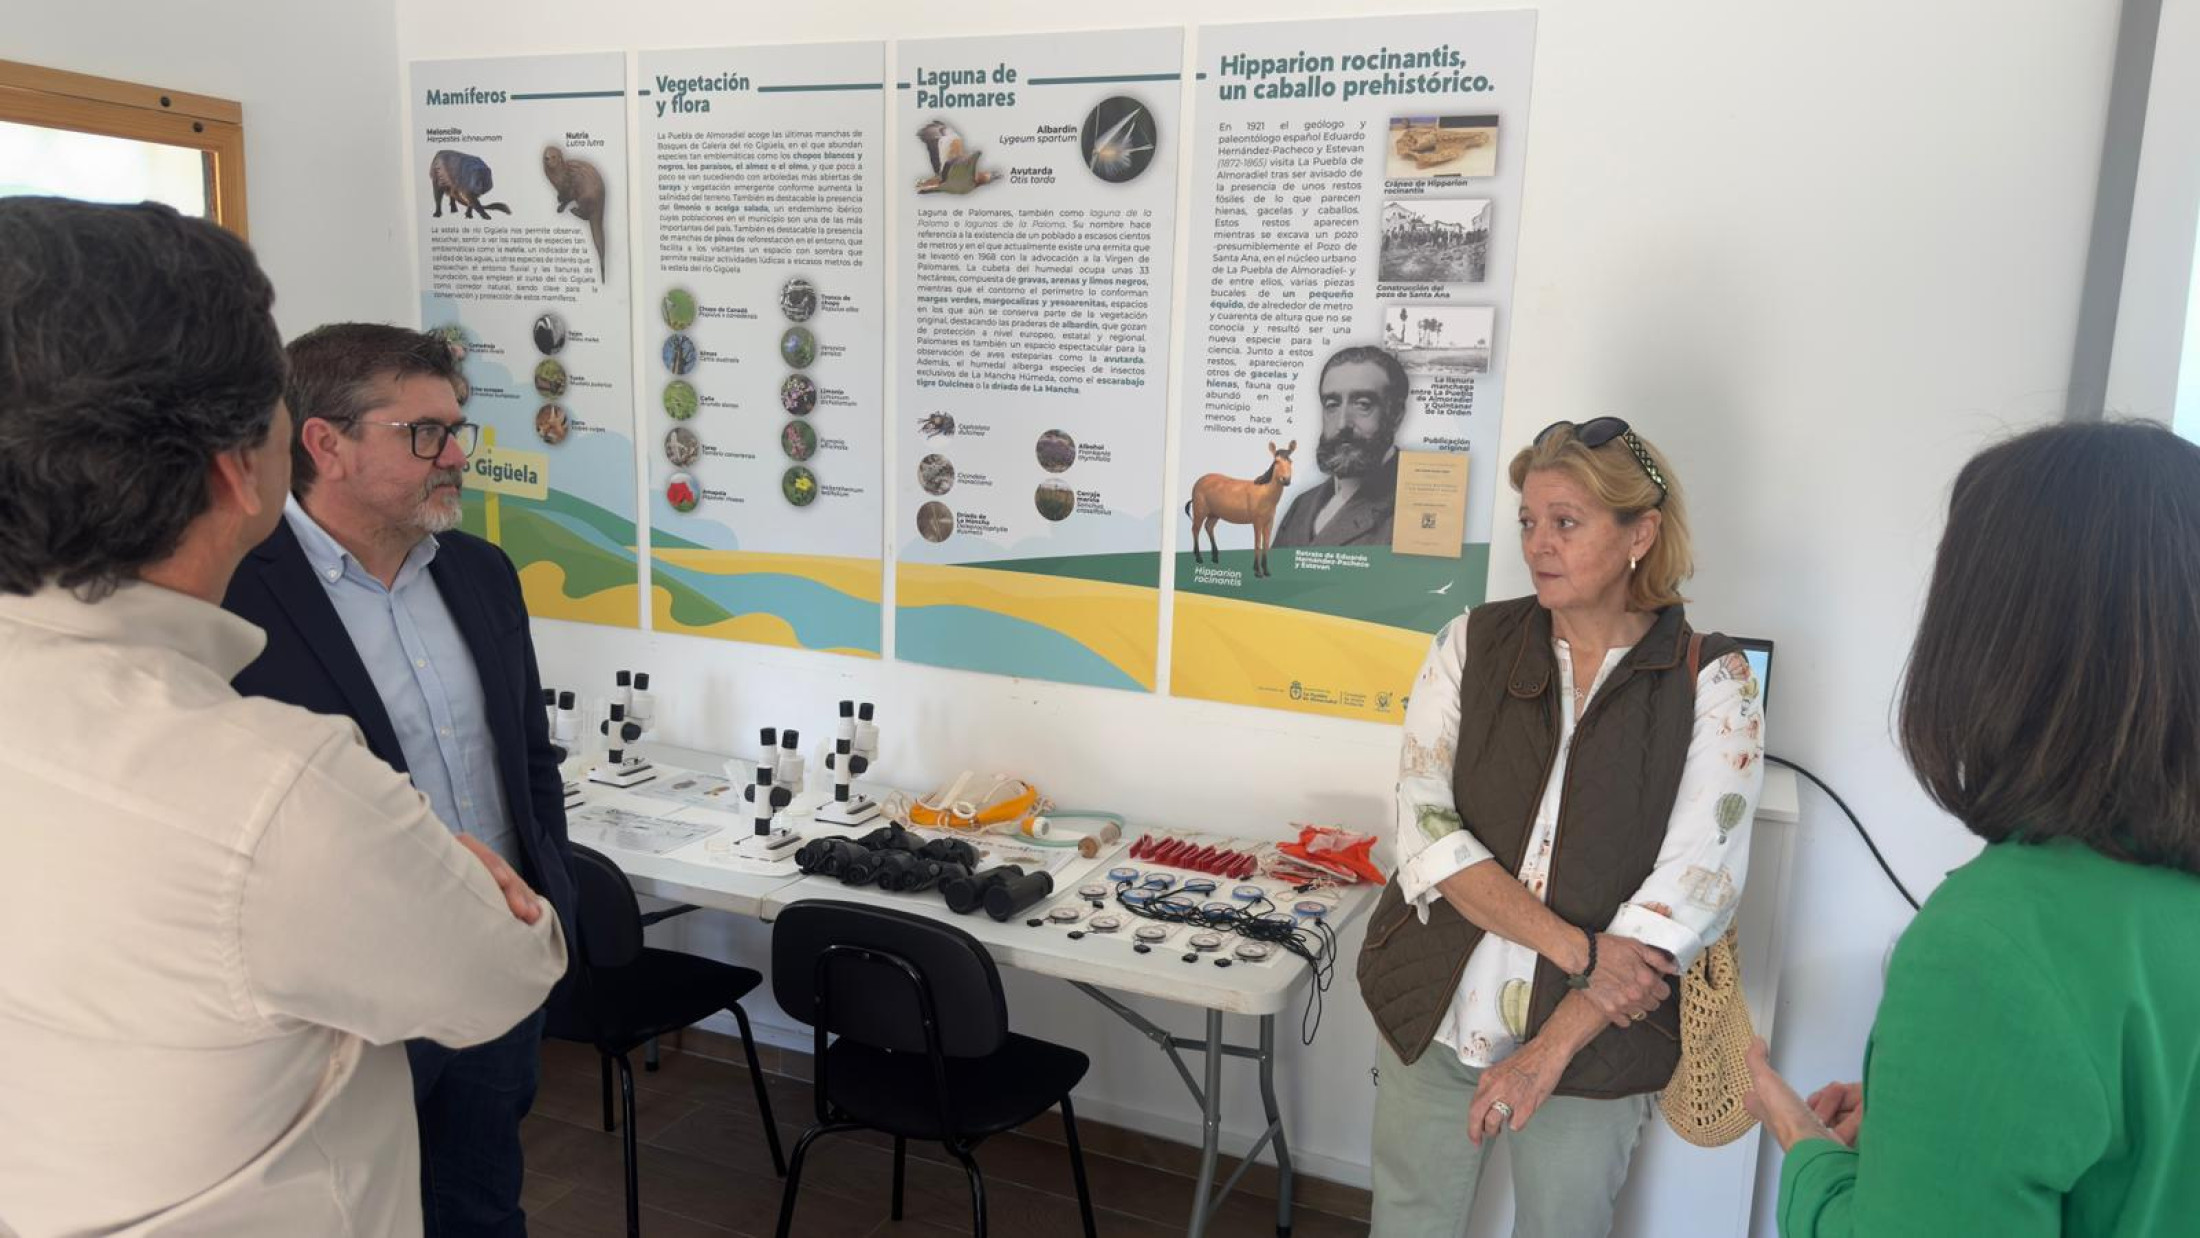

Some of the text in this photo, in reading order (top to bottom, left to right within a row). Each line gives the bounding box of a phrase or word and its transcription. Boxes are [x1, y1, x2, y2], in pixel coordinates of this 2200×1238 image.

[1220, 44, 1466, 83] Hipparion rocinantis,
[918, 63, 1016, 90] Laguna de
[656, 72, 749, 95] Vegetación
[1220, 70, 1494, 101] un caballo prehistórico.
[426, 86, 506, 105] Mamíferos
[918, 87, 1015, 109] Palomares
[656, 96, 710, 117] y flora
[1219, 119, 1365, 131] En 1921 el geólogo y
[1218, 131, 1364, 145] paleontólogo español Eduardo
[1217, 143, 1364, 155] Hernández-Pacheco y Estevan
[1269, 156, 1294, 166] visita
[1297, 156, 1309, 165] La
[1312, 155, 1346, 165] Puebla
[1350, 155, 1363, 164] de
[1216, 169, 1268, 178] Almoradiel
[1270, 168, 1288, 178] tras
[1309, 168, 1346, 178] avisado
[1349, 168, 1362, 177] de
[1216, 180, 1361, 192] la presencia de unos restos
[1215, 193, 1360, 204] fósiles de lo que parecen
[1214, 205, 1246, 215] hienas,
[1257, 205, 1292, 216] gacelas
[1302, 207, 1307, 216] y
[1214, 217, 1358, 227] Estos restos aparecen
[1213, 228, 1254, 238] mientras
[1334, 231, 1358, 240] pozo
[1304, 241, 1312, 250] el
[1316, 241, 1340, 250] Pozo
[1344, 241, 1357, 250] de
[1206, 366, 1298, 381] otros de gacelas y
[1206, 378, 1294, 392] hienas, fauna que
[1205, 400, 1293, 413] municipio al
[1203, 422, 1242, 433] millones
[1244, 424, 1255, 434] de
[476, 458, 537, 484] Gigüela
